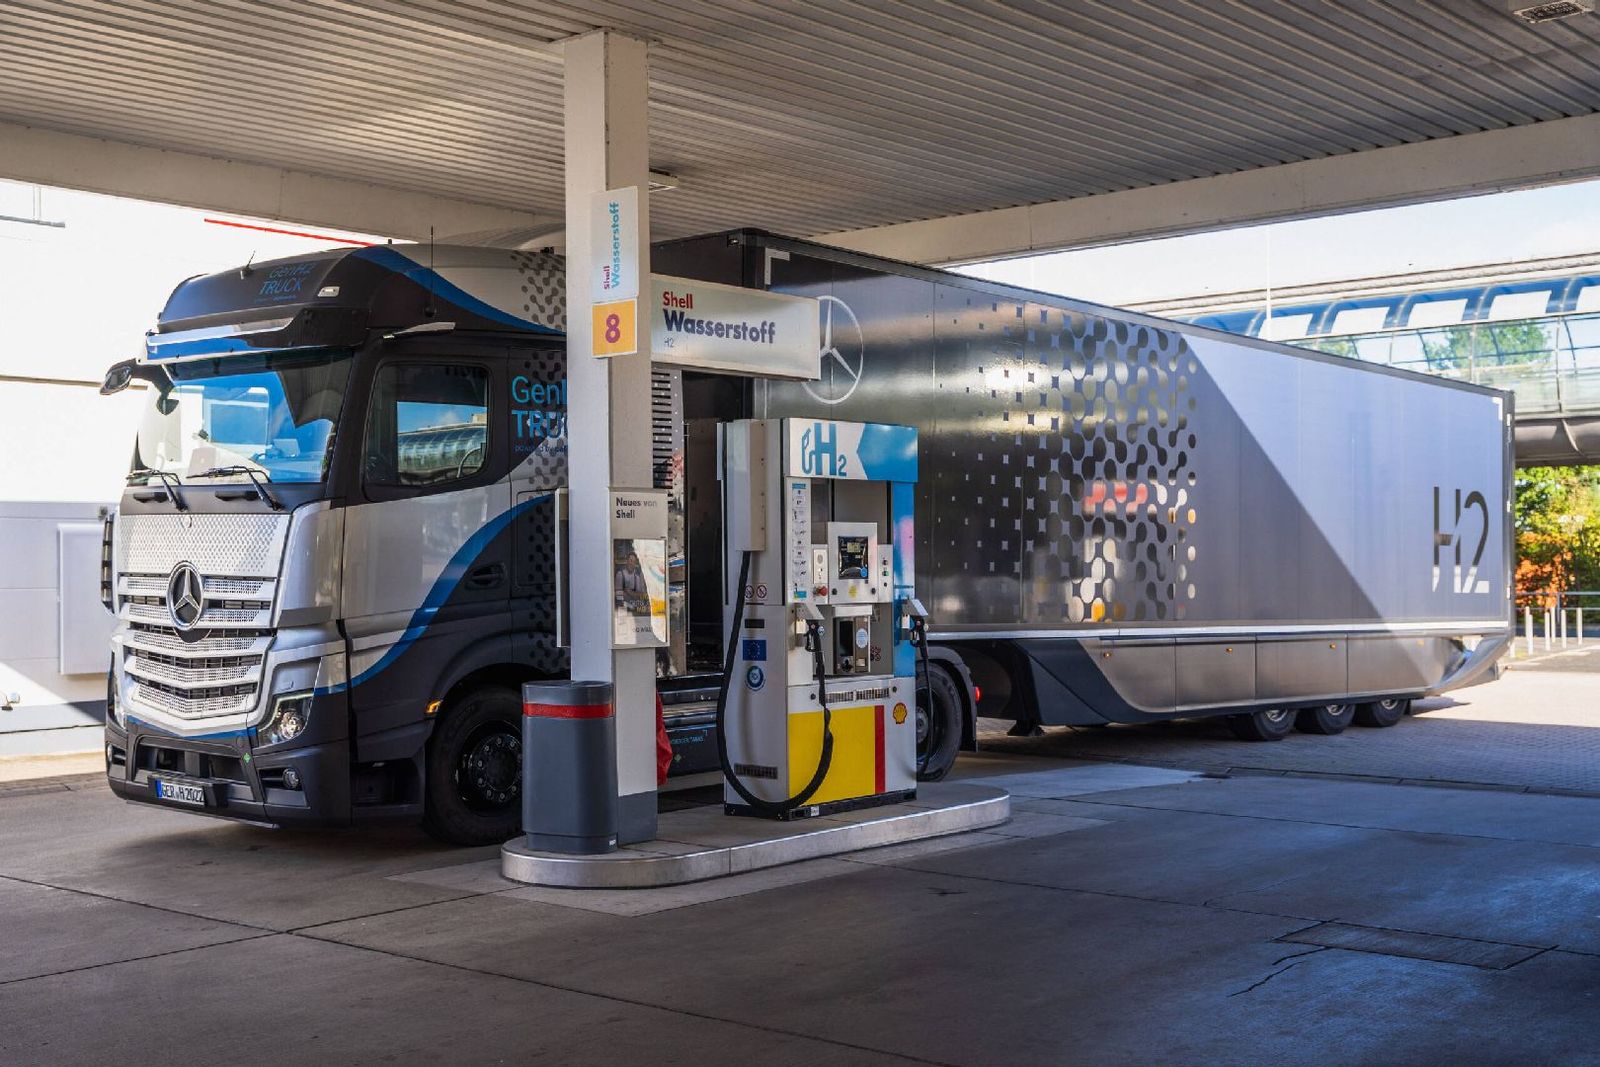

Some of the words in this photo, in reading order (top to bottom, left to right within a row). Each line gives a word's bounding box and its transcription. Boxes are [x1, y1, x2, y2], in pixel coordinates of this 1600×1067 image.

[609, 202, 620, 289] Wasserstoff
[259, 279, 303, 295] TRUCK
[663, 291, 693, 309] Shell
[605, 313, 621, 344] 8
[662, 308, 776, 344] Wasserstoff
[511, 409, 568, 439] TRU
[616, 497, 641, 507] Neues
[616, 509, 635, 519] Shell
[1432, 486, 1490, 593] H2
